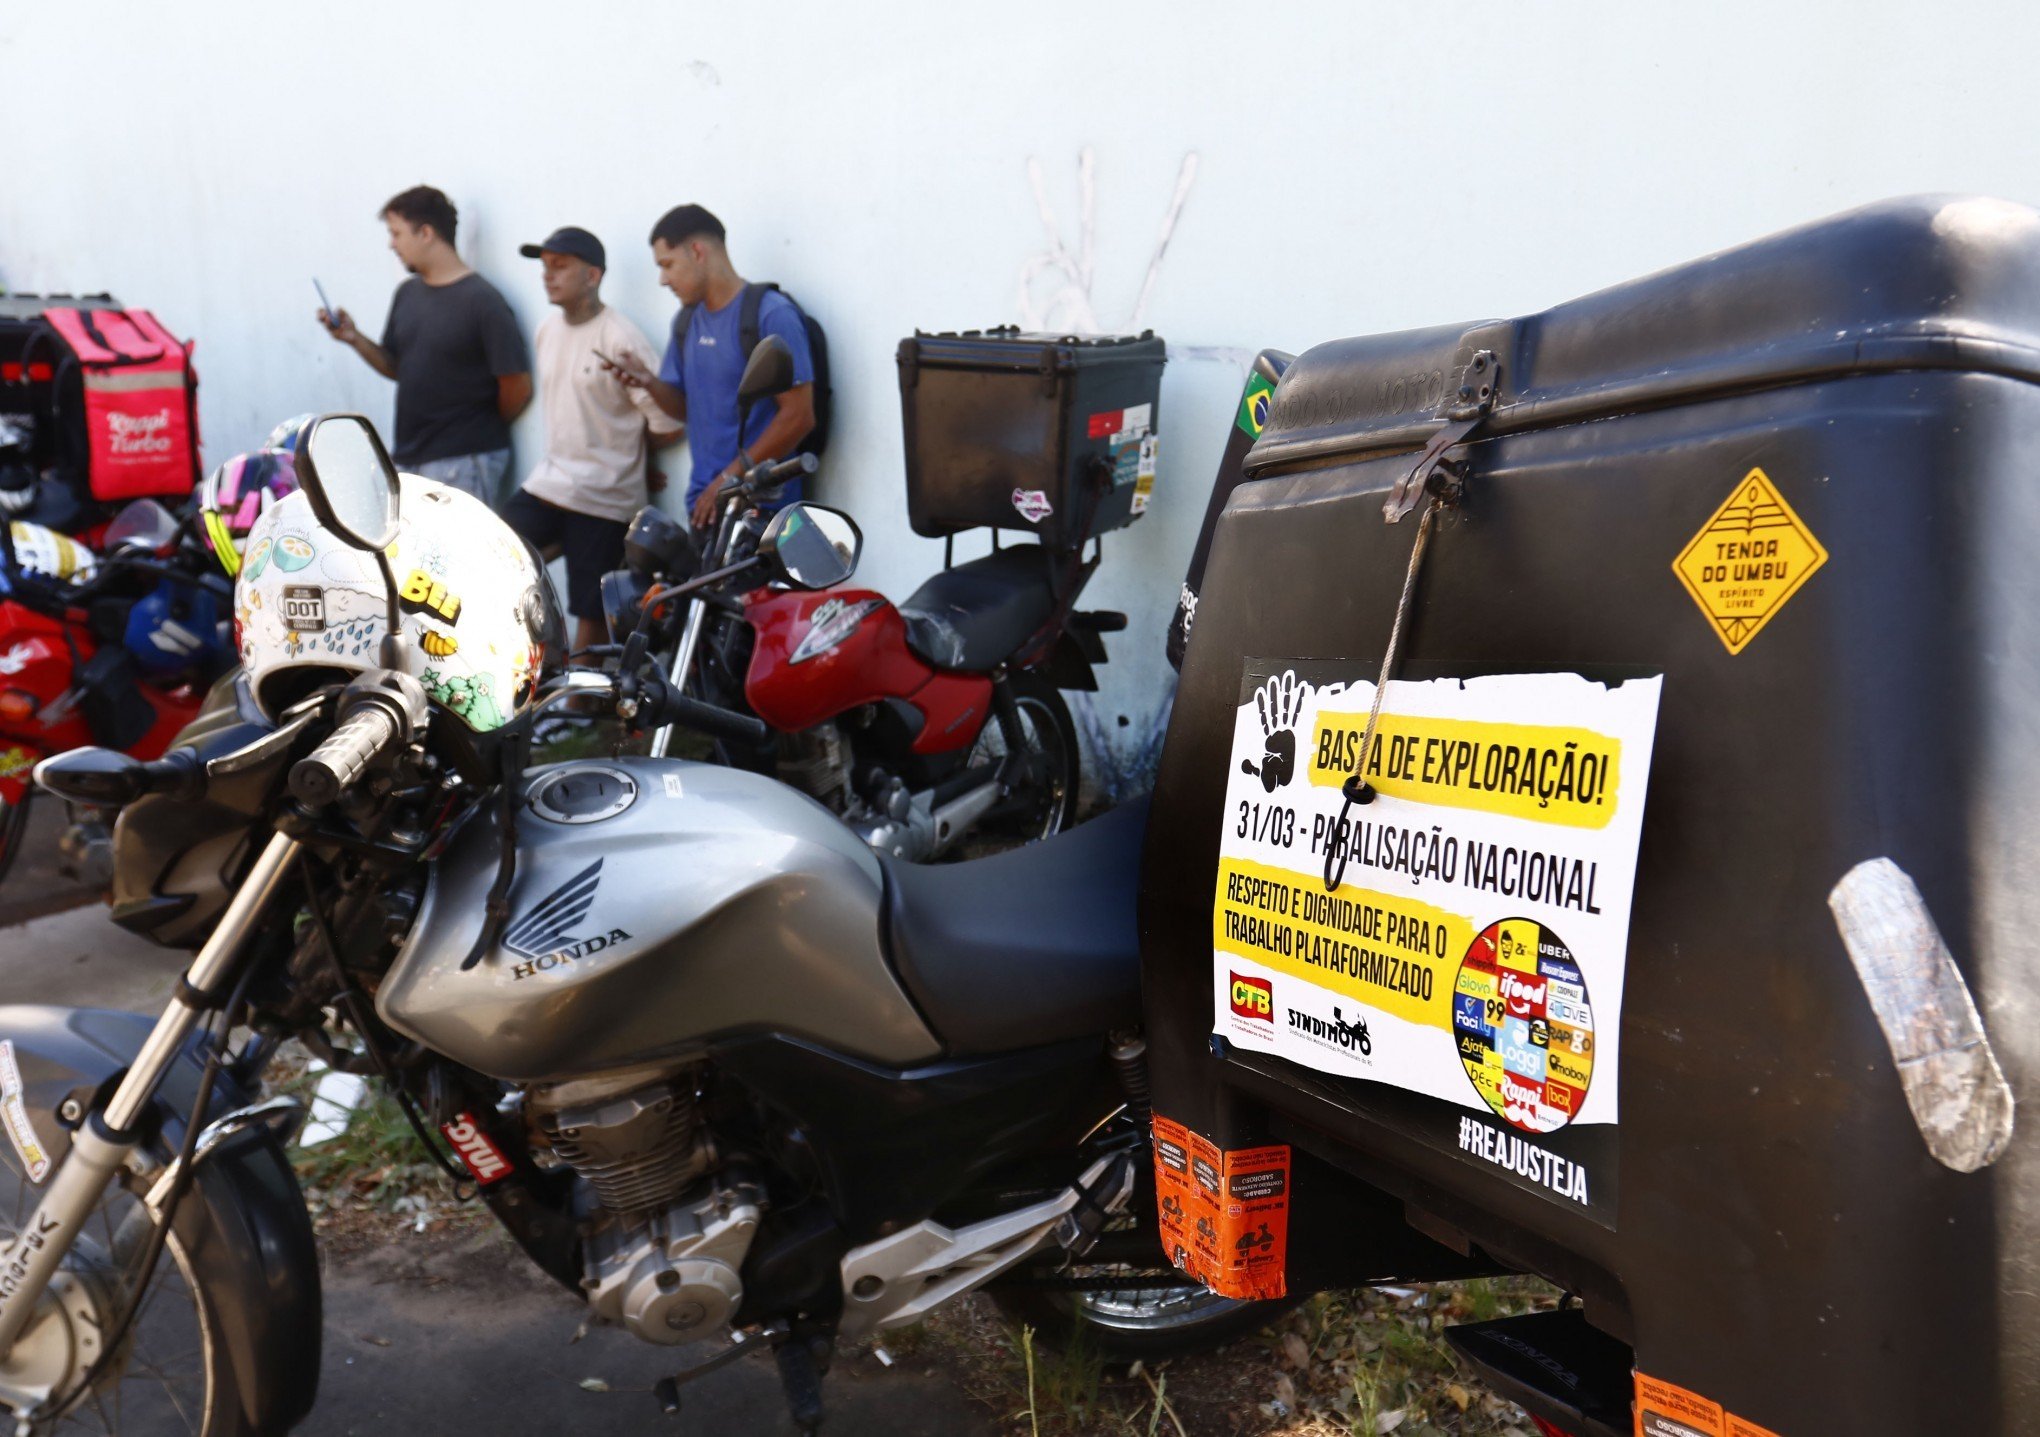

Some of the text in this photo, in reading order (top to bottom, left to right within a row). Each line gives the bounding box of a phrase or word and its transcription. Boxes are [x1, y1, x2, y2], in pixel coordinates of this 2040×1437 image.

[106, 408, 169, 432] Rappi
[109, 434, 172, 453] Turbo
[1717, 540, 1778, 560] TENDA
[1702, 562, 1788, 583] DO UMBU
[286, 601, 319, 617] DOT
[399, 568, 462, 622] BEE
[1726, 600, 1755, 609] LIVRE
[1316, 728, 1609, 808] BASA DE EXPLORAÇÃO!
[1237, 800, 1295, 847] 31/03
[1311, 813, 1458, 885] PARALISAÇÃO
[1464, 840, 1601, 915] NACIONAL
[1227, 872, 1447, 959] RESPEITO E DIGNIDADE PARA O
[510, 928, 633, 981] HONDA
[1224, 910, 1433, 1001] TRABALHO PLATAFORMIZADO
[1539, 943, 1570, 960] UBER
[1232, 981, 1270, 1014] CTB
[1459, 974, 1490, 994] Glovo
[1500, 971, 1546, 1005] ifood
[1486, 999, 1506, 1021] 99
[1288, 1008, 1372, 1056] SINDIMOTO
[1498, 1038, 1541, 1074] Loggi
[1500, 1074, 1542, 1109] Rappi
[446, 1113, 505, 1179] OTUL
[1458, 1116, 1588, 1206] #REAJUSTEJA
